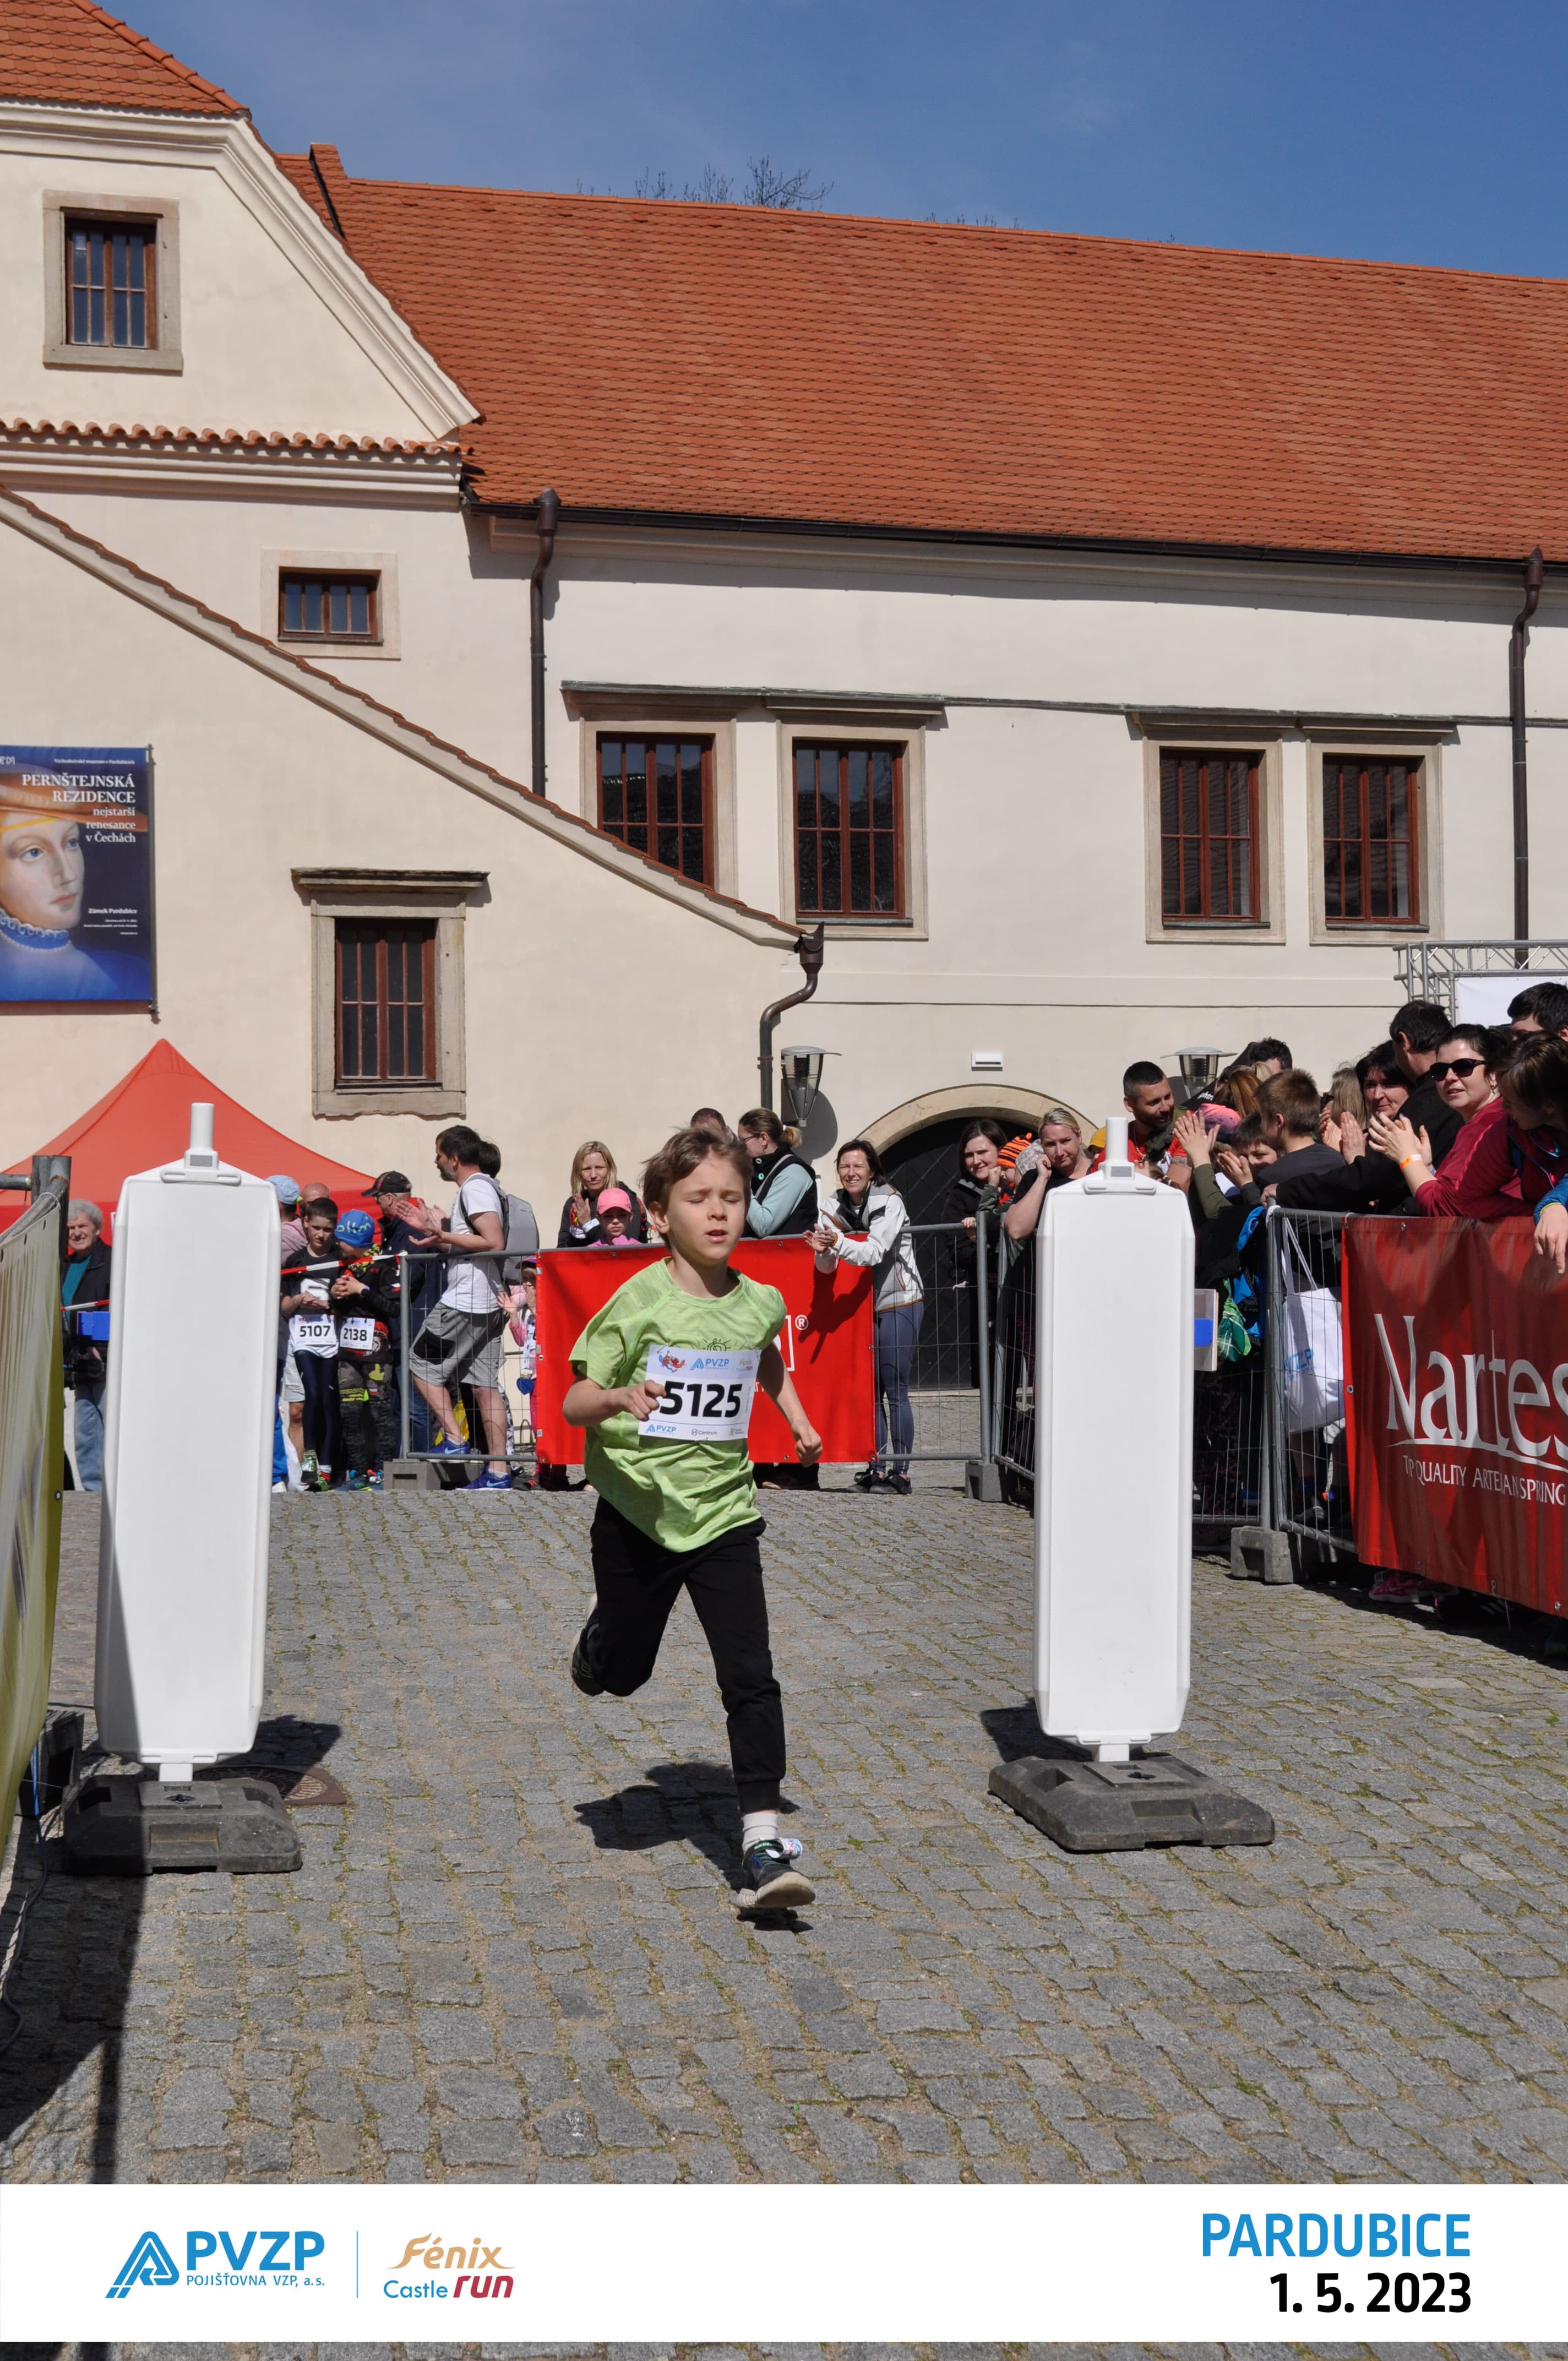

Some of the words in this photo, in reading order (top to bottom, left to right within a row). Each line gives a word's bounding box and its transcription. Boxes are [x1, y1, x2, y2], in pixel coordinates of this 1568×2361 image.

[22, 773, 135, 787] PERNŠTEJNSKÁ
[52, 791, 136, 803] REZIDENCE
[92, 807, 136, 818] nejstarší
[94, 831, 136, 842] Čechách
[300, 1325, 331, 1337] 5107
[343, 1328, 367, 1341] 2138
[705, 1358, 729, 1367] PVZP
[659, 1380, 743, 1418] 5125
[656, 1424, 677, 1433] PVZP
[1415, 1461, 1467, 1486] QUALITY
